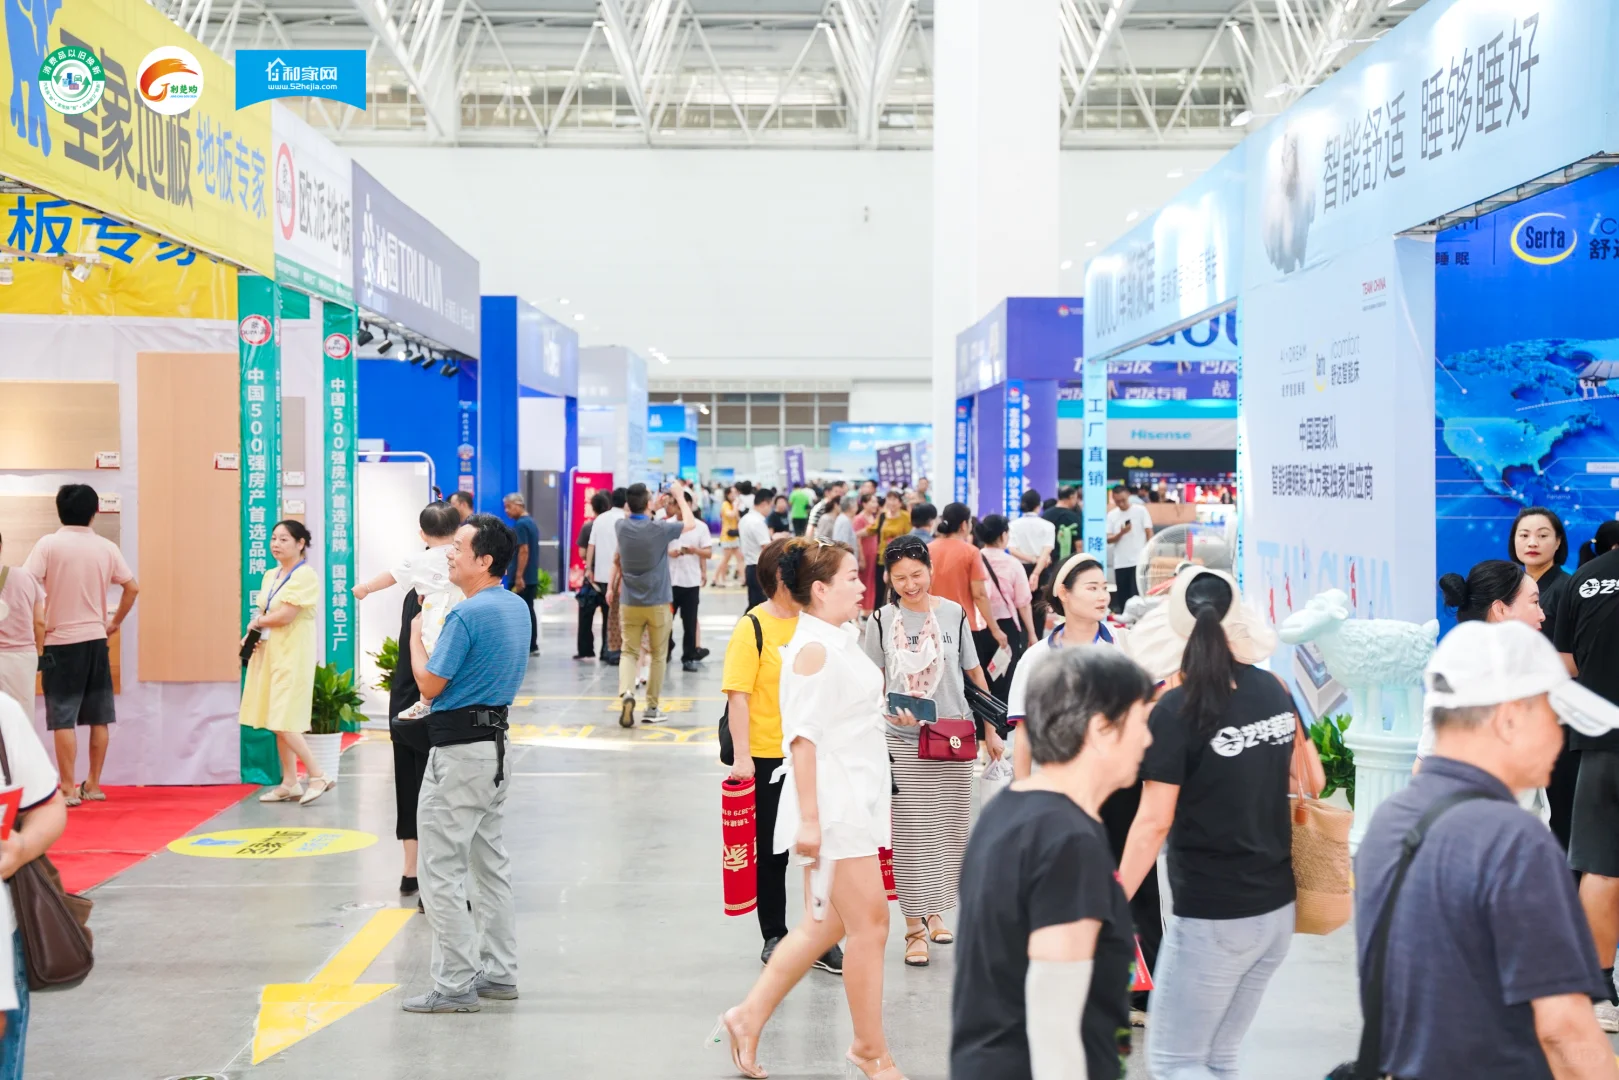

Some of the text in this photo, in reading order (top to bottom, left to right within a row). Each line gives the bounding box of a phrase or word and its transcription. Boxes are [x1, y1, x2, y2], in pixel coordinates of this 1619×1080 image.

[1323, 12, 1540, 214] 智能舒适 睡够睡好
[196, 111, 267, 220] 地板专家
[1525, 226, 1566, 249] Serta
[1087, 398, 1104, 487] 工厂直销
[1130, 429, 1192, 440] Hisense
[1299, 414, 1338, 451] 中国国家队
[247, 367, 267, 575] 中国500强房产首选品牌
[1271, 462, 1373, 500] 智能睡眠解决方案独家供应商
[330, 377, 348, 652] 中国500强房产首选品牌 国家绿色工厂
[1600, 579, 1619, 594] 艺
